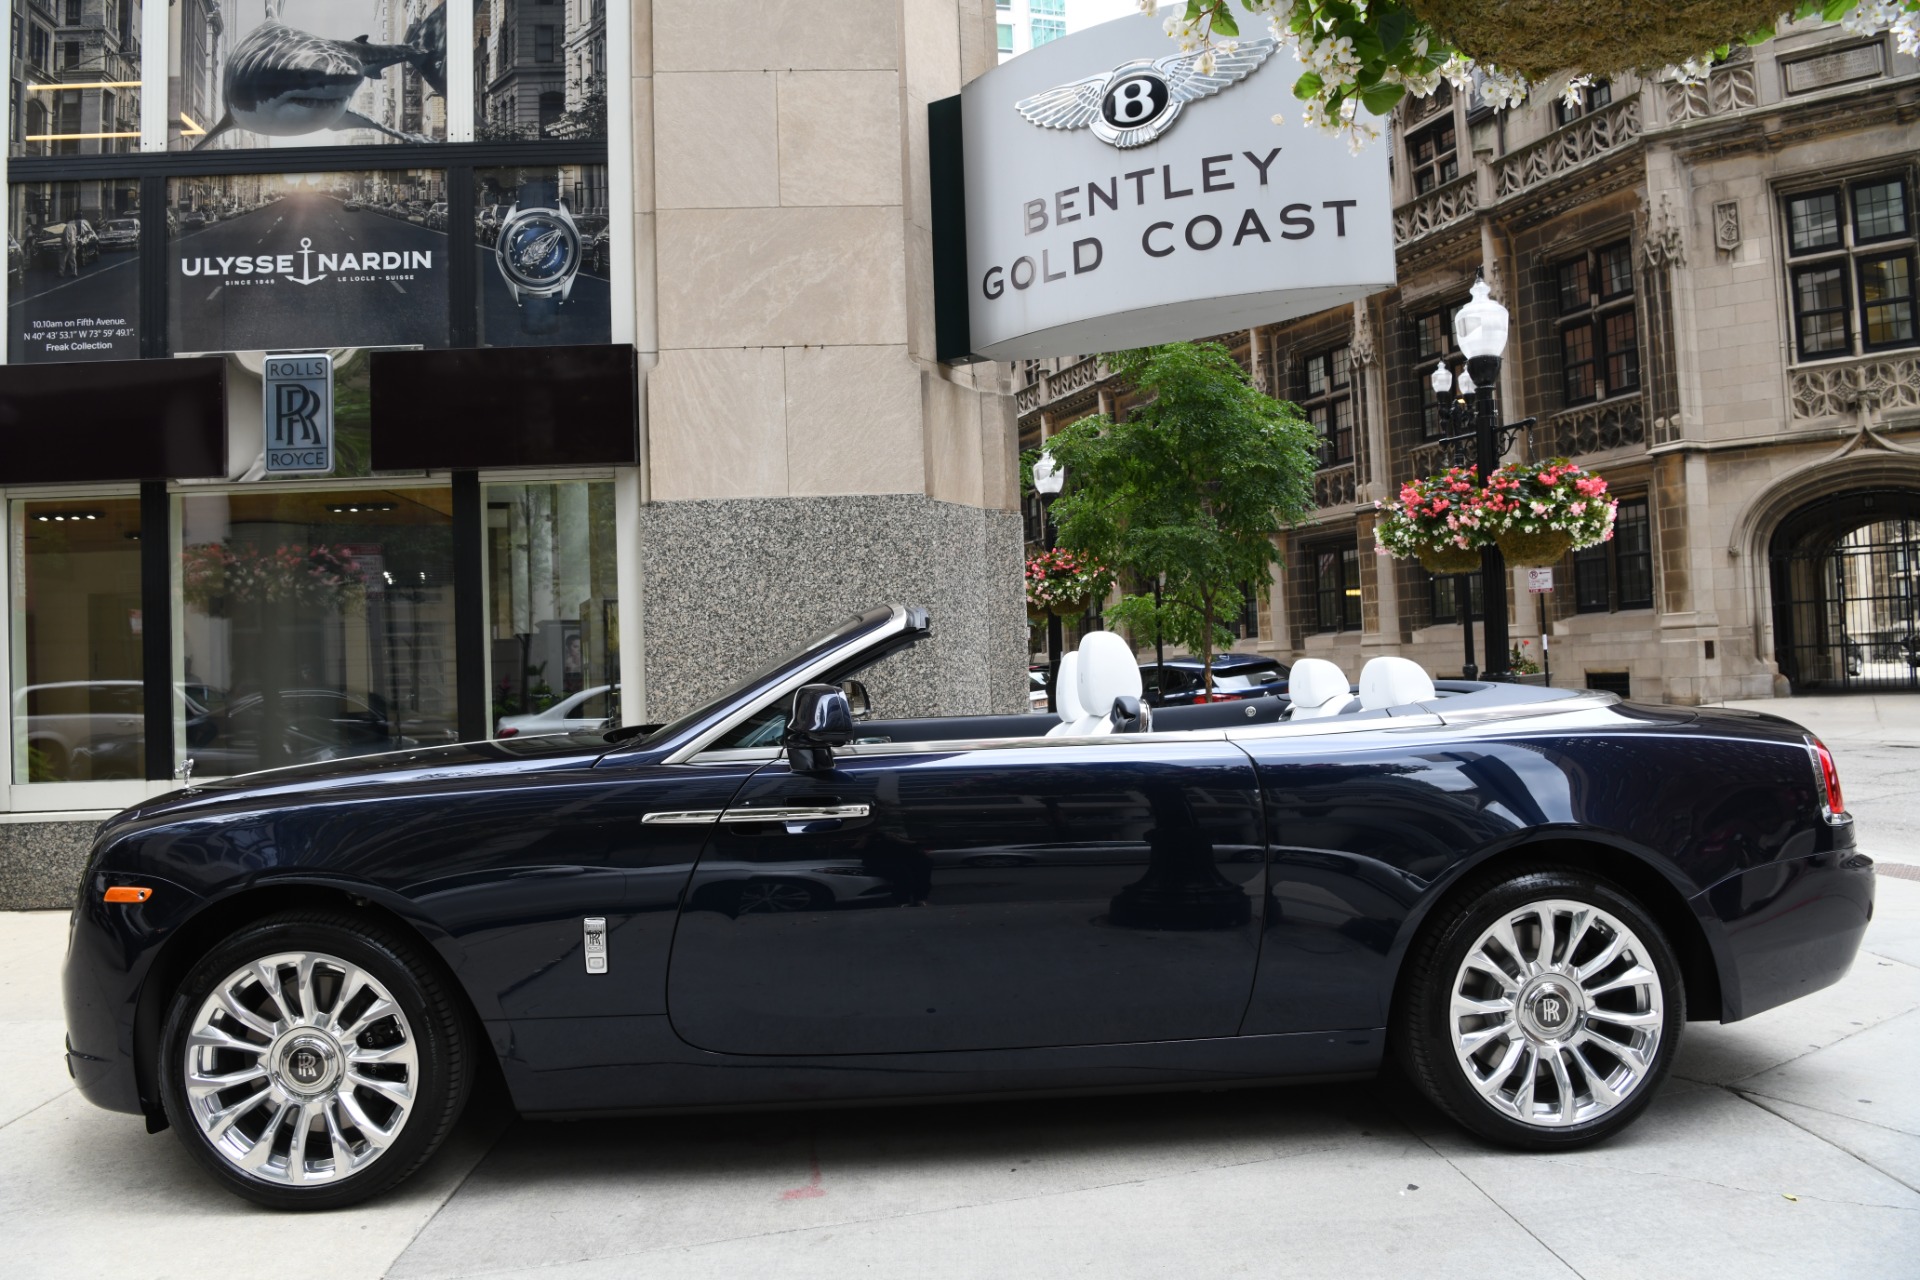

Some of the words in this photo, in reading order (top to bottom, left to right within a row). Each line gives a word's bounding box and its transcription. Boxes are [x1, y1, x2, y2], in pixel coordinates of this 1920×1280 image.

[1023, 147, 1282, 236] BENTLEY
[982, 236, 1103, 301] GOLD
[1141, 199, 1357, 258] COAST
[181, 254, 294, 277] ULYSSE
[318, 250, 432, 272] NARDIN
[23, 332, 31, 341] N
[32, 332, 45, 340] 40°
[78, 330, 88, 338] W
[89, 330, 102, 338] 73°
[32, 320, 62, 329] 10.10am
[76, 318, 94, 327] Fifth
[95, 318, 127, 326] Avenue.
[46, 342, 69, 352] Freak
[70, 341, 113, 351] Collection
[270, 361, 323, 377] ROLLS
[275, 383, 322, 446] RR
[271, 451, 324, 466] ROYCE
[1542, 998, 1560, 1022] RR
[298, 1052, 317, 1077] RR
